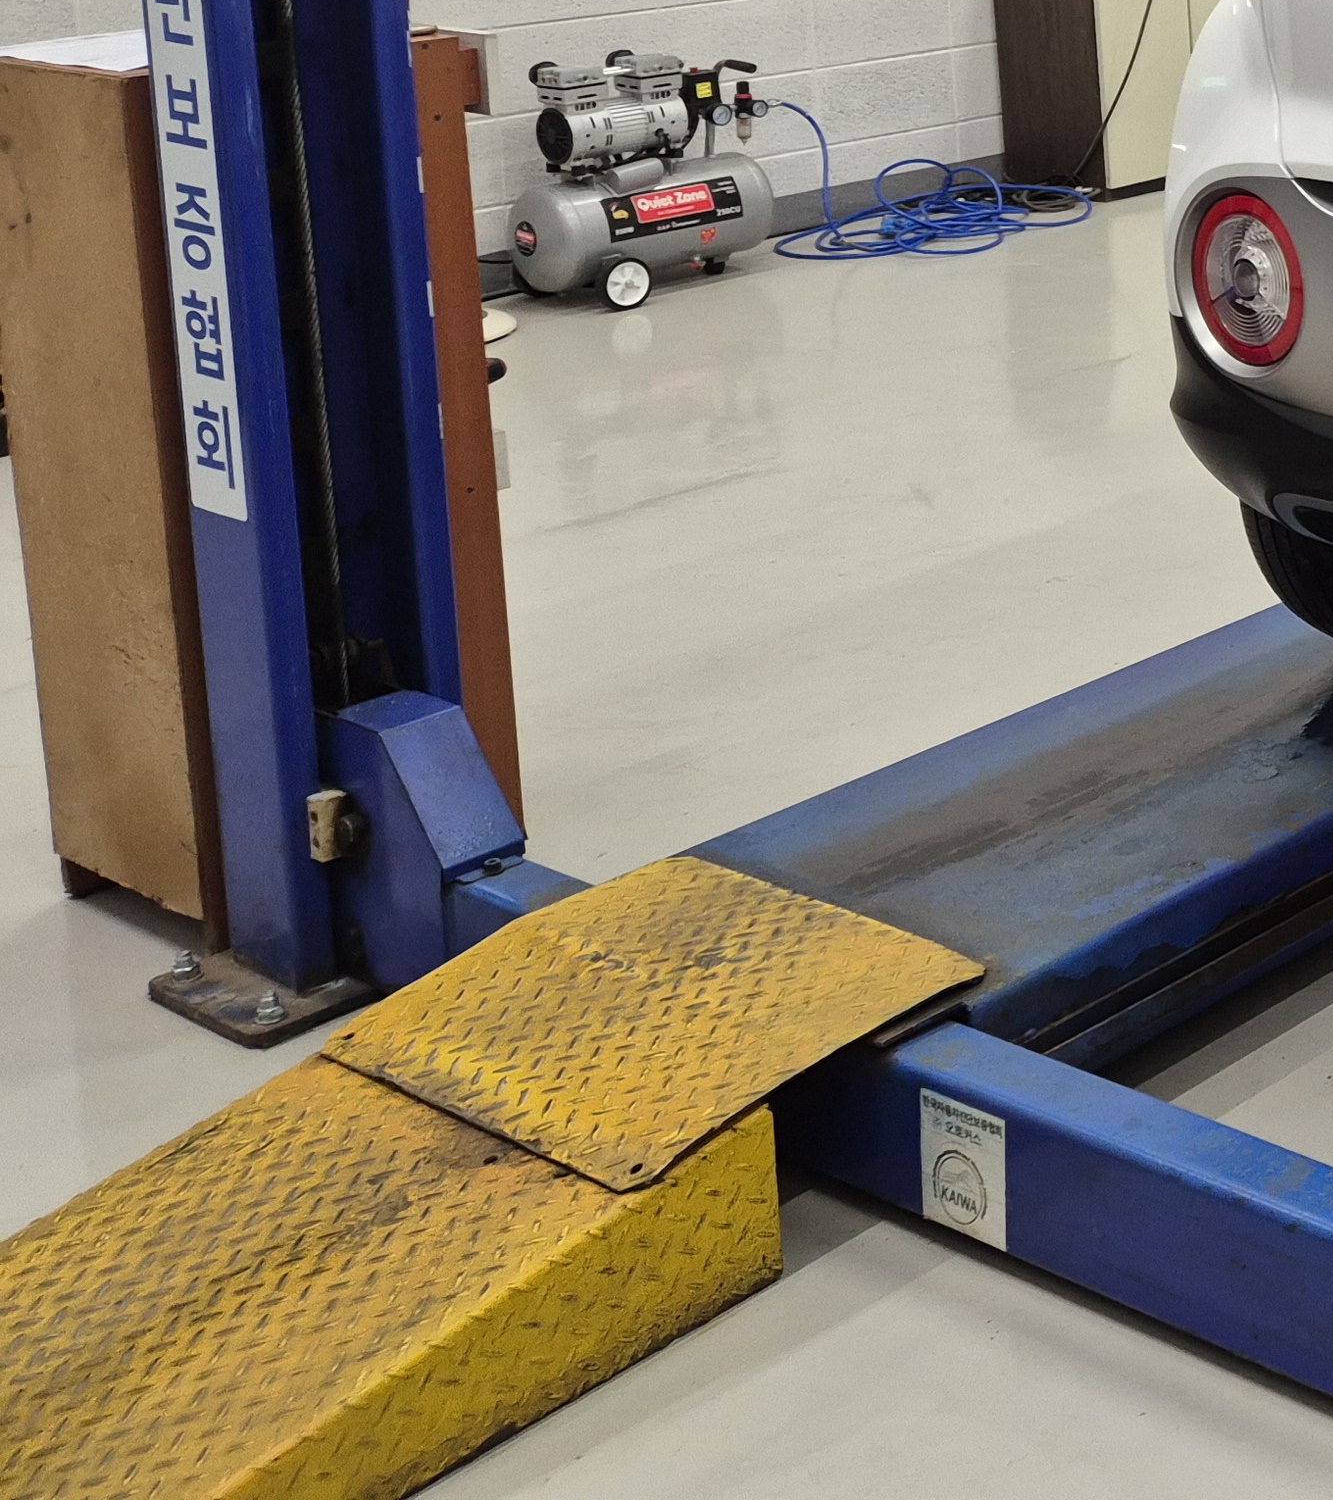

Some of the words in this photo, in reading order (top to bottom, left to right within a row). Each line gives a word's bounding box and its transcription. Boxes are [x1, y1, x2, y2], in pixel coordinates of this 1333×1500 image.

[637, 194, 673, 212] Quiet
[676, 188, 708, 204] Zone
[941, 1185, 978, 1214] KAIWA
